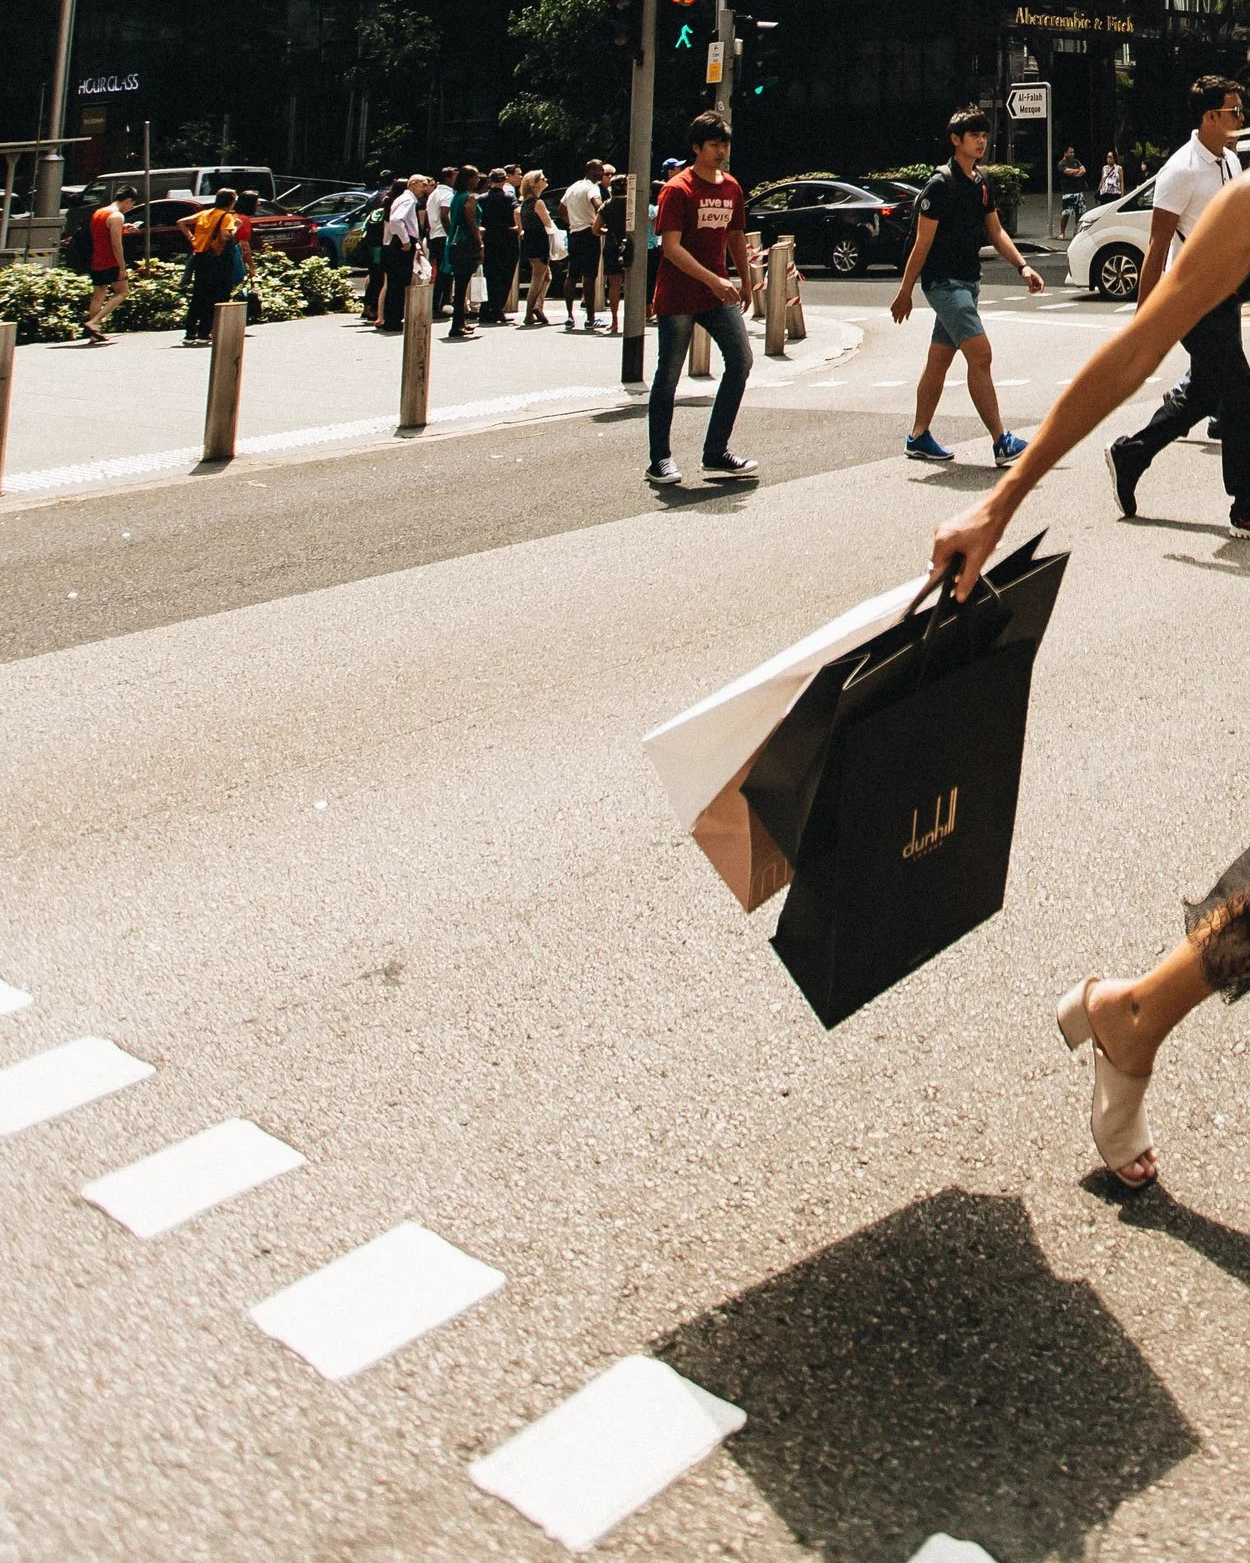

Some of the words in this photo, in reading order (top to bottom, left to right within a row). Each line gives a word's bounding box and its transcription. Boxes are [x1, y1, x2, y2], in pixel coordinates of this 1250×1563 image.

[1015, 6, 1092, 30] Abercrombie
[1093, 17, 1104, 30] &
[1018, 92, 1043, 102] Al-Falah
[1019, 105, 1041, 115] Mosque
[903, 787, 958, 859] dunhill
